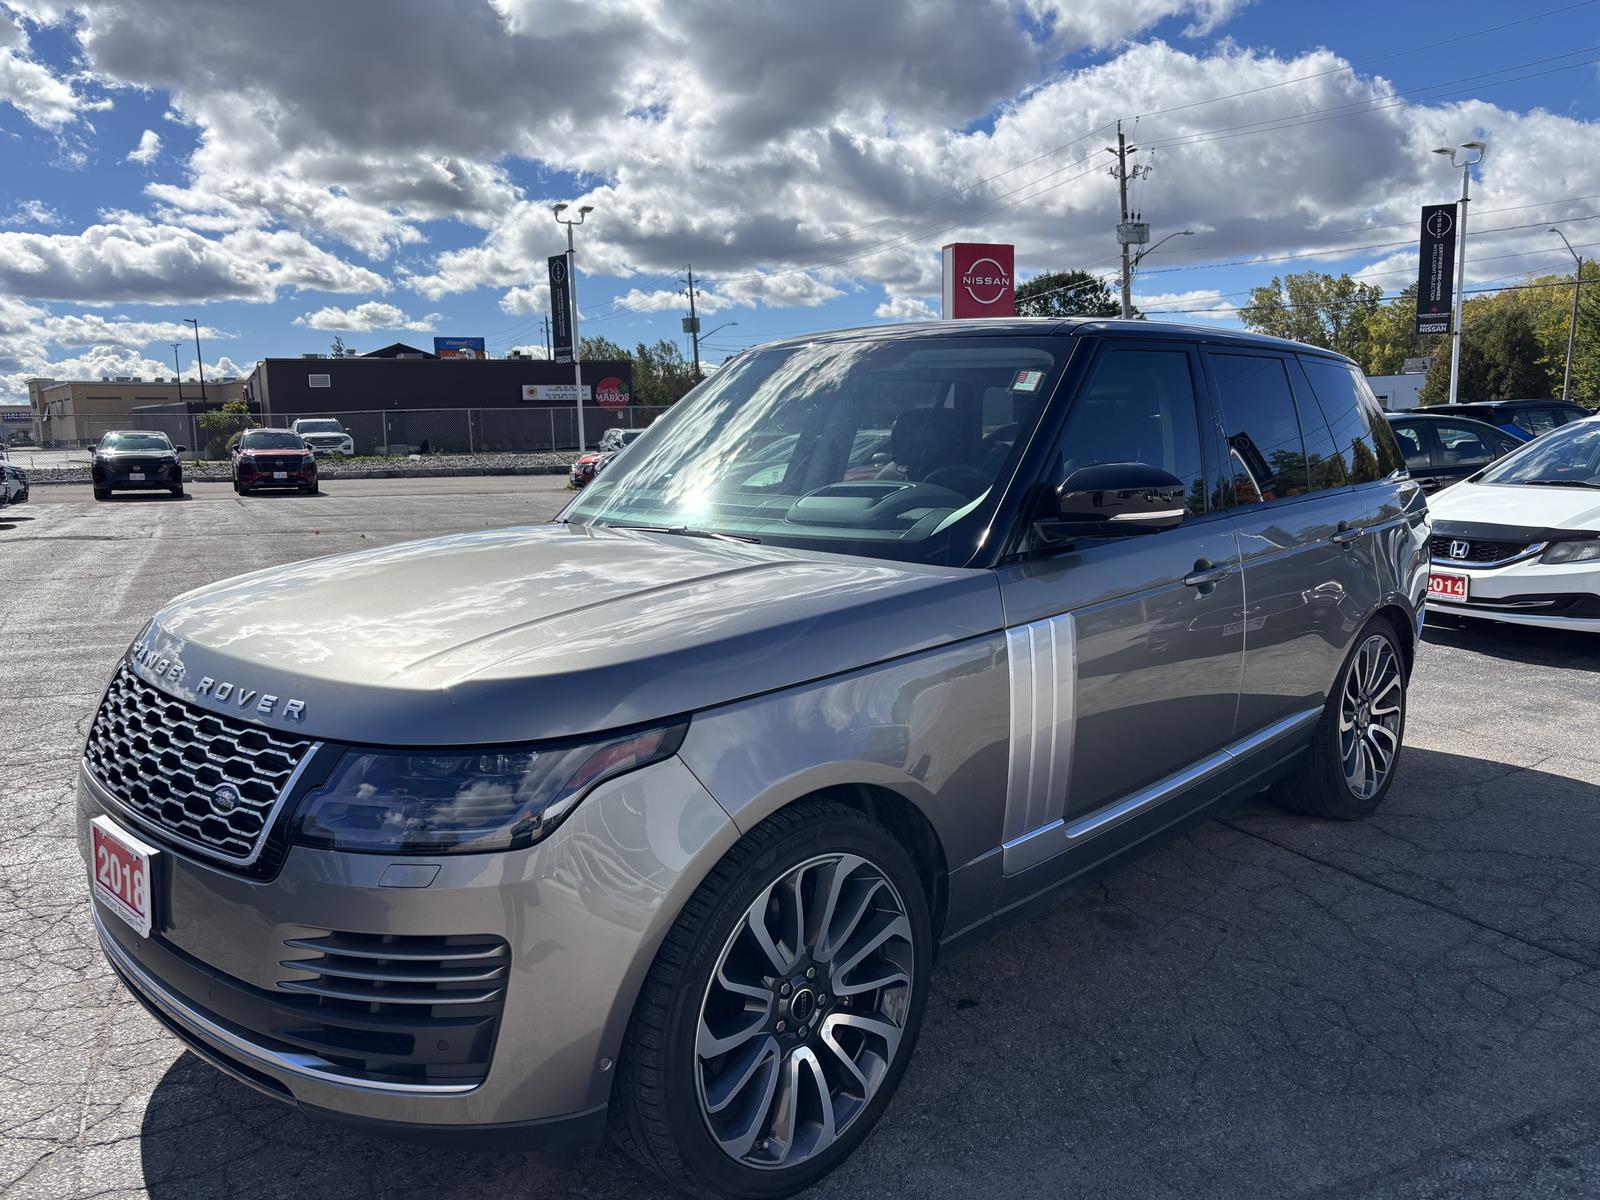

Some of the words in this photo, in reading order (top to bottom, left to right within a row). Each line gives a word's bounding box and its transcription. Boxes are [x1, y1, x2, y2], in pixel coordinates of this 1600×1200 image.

[962, 276, 1010, 286] NISSAN
[1428, 577, 1464, 594] 2014
[134, 642, 185, 682] RANGE
[196, 676, 305, 719] ROVER
[98, 845, 144, 914] 2018
